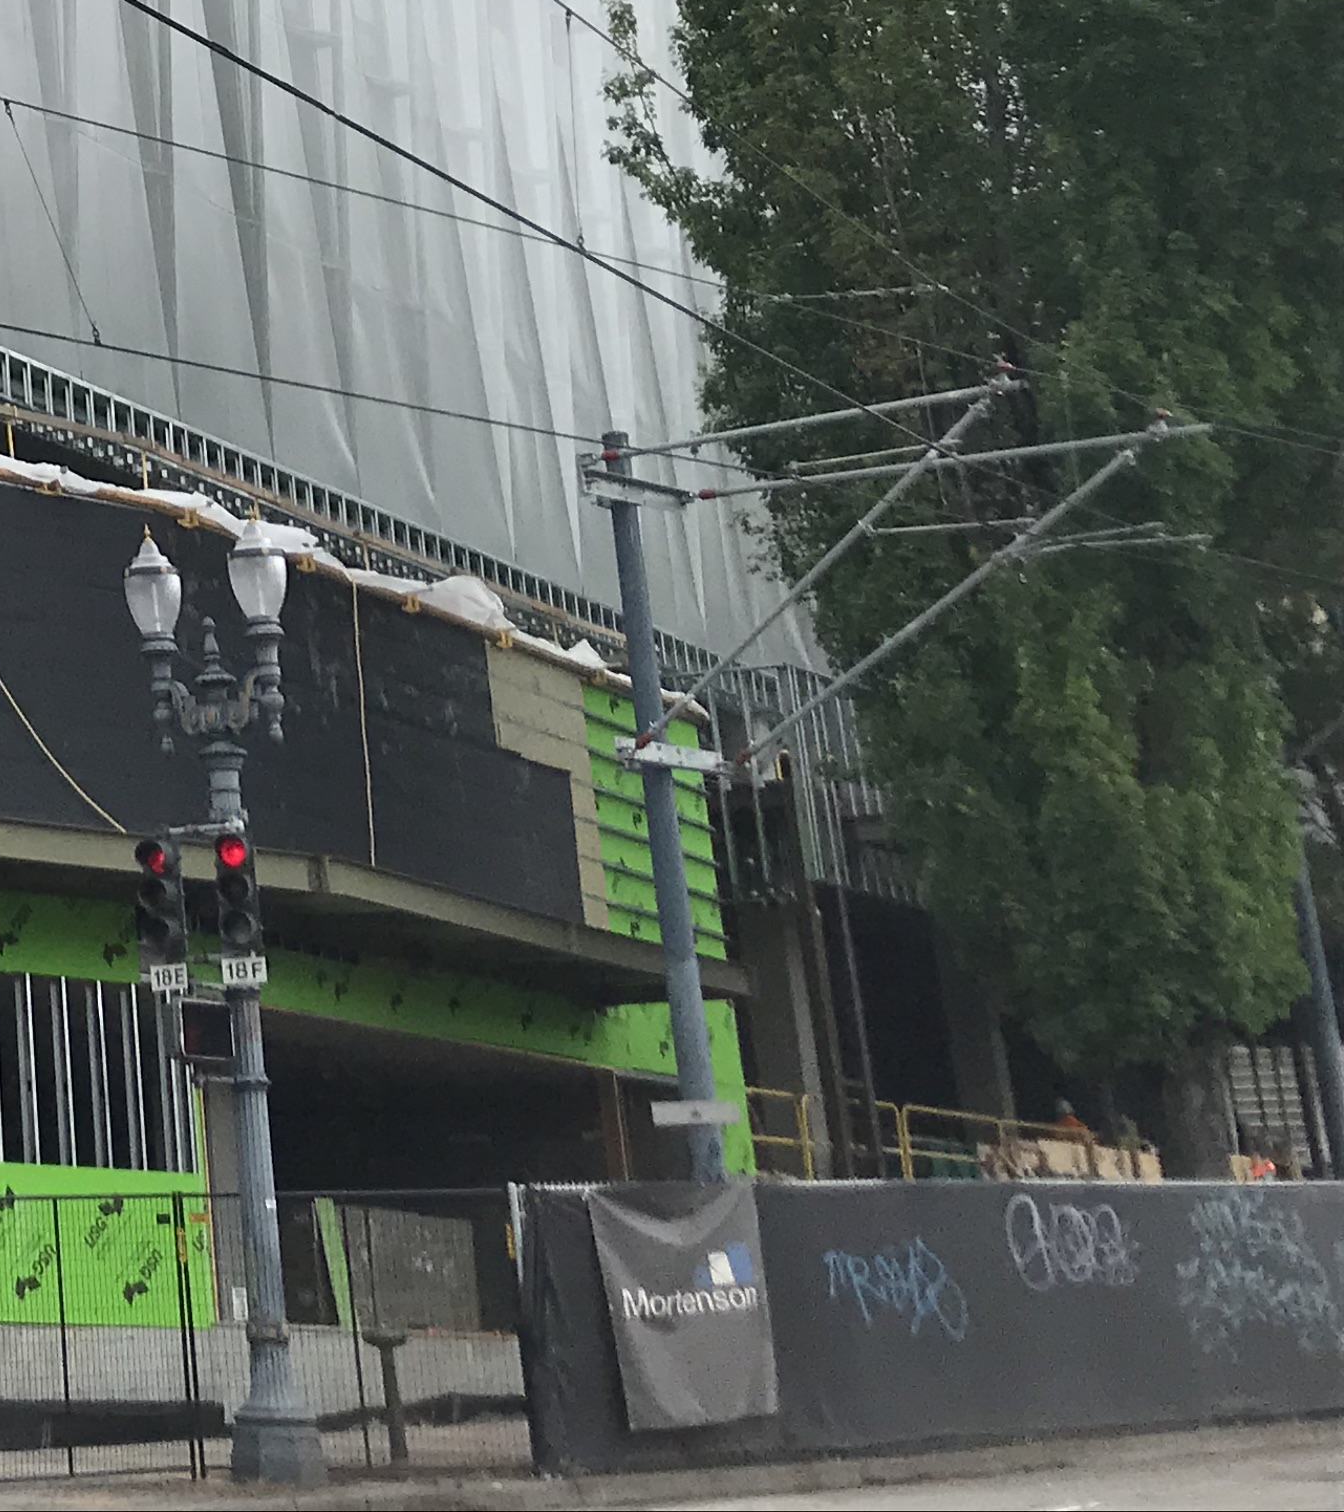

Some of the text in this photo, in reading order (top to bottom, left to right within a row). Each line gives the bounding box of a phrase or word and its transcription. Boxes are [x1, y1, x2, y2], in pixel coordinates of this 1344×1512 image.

[154, 968, 185, 988] 18E
[226, 960, 263, 981] 18F
[84, 1216, 108, 1249] USG
[32, 1244, 57, 1276] USG
[622, 1286, 758, 1320] Mortenson
